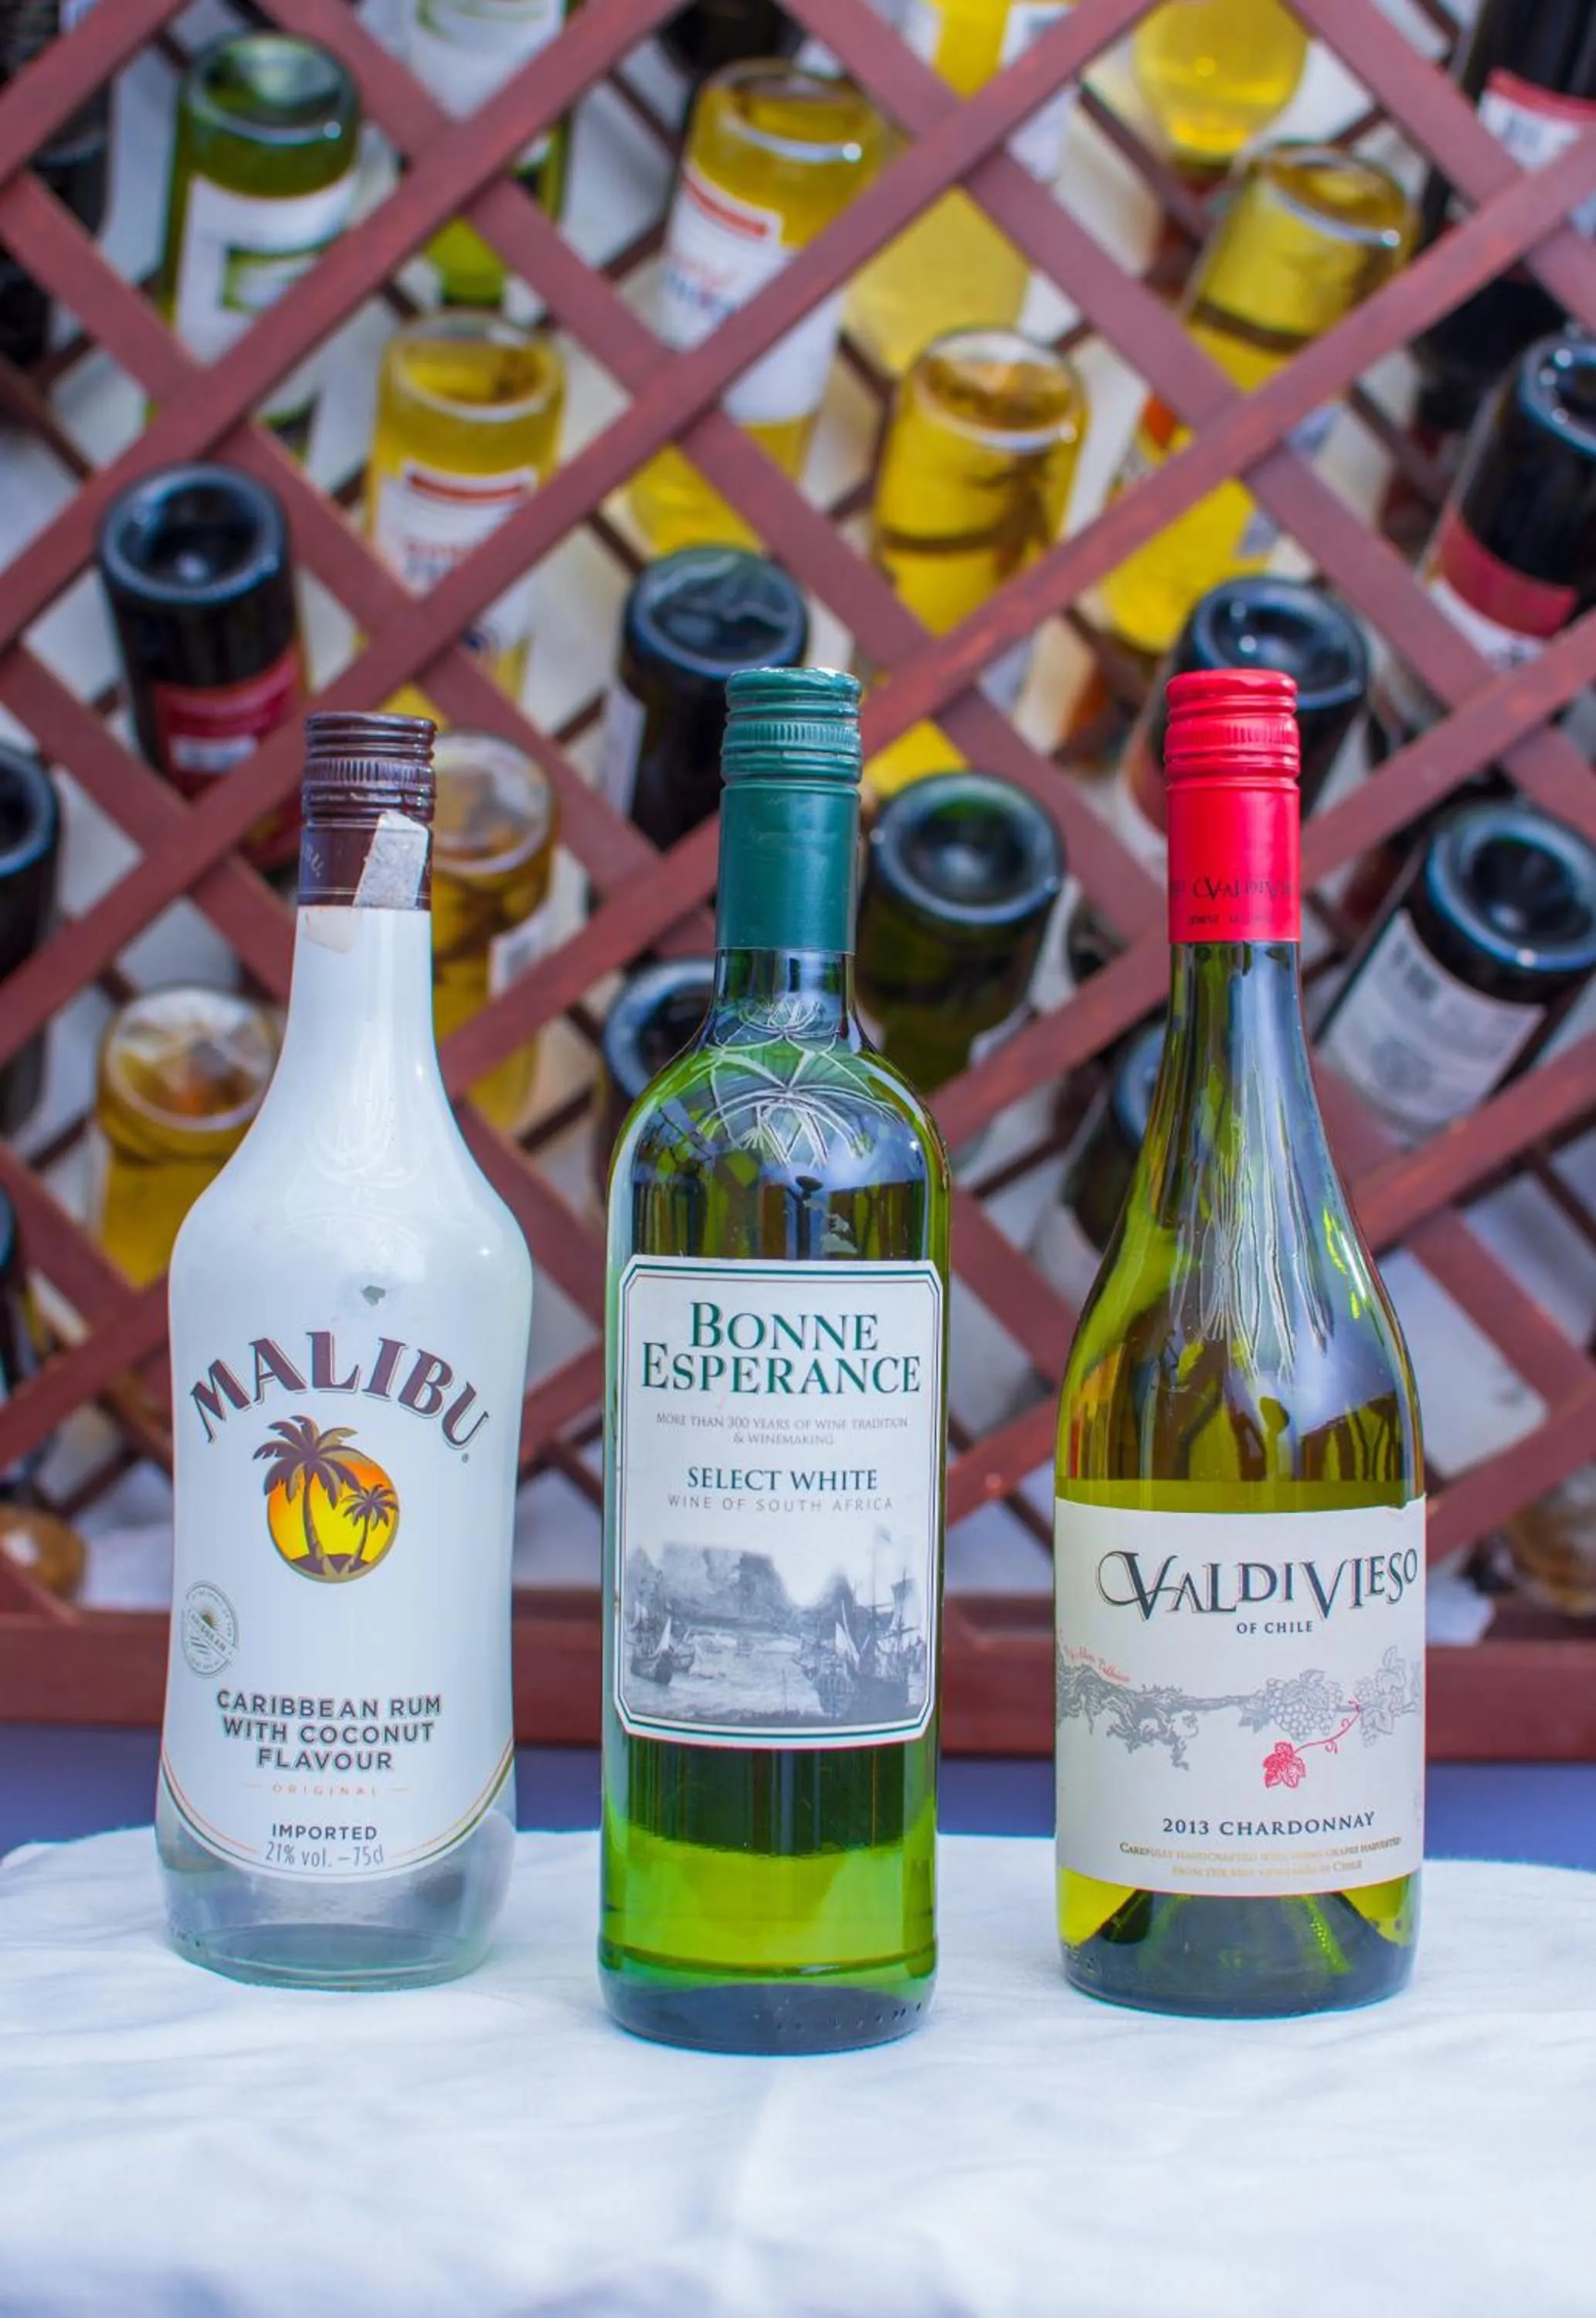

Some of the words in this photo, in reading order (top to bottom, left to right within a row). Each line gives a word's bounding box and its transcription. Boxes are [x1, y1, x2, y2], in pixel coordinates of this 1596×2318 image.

[690, 1302, 878, 1351] BONNE
[642, 1342, 921, 1394] ESPERANCE
[190, 1331, 490, 1450] MALIBU
[657, 1412, 685, 1426] MORE
[691, 1416, 724, 1427] THAN
[727, 1416, 749, 1429] 300
[752, 1418, 790, 1429] YEARS
[793, 1419, 811, 1429] OF
[815, 1419, 846, 1429] WINE
[851, 1416, 908, 1429] TRADITION
[733, 1433, 743, 1443] &
[748, 1433, 834, 1445] WINEMAKING
[688, 1467, 782, 1491] SELECT
[790, 1470, 878, 1491] WHITE
[667, 1494, 711, 1509] WINE
[722, 1497, 745, 1511] OF
[756, 1498, 821, 1512] SOUTH
[832, 1497, 894, 1512] AFRICA
[1097, 1548, 1418, 1621] VALDIVIESO
[1236, 1622, 1258, 1634] OF
[1265, 1620, 1314, 1634] CHILE
[216, 1689, 379, 1718] CARIBBEAN
[389, 1693, 441, 1717] RUM
[223, 1715, 287, 1742] WITH
[299, 1722, 434, 1744] COCONUT
[257, 1747, 393, 1771] FLAVOUR
[272, 1783, 377, 1796] ORIGINAL
[272, 1823, 378, 1840] IMPORTED
[1163, 1817, 1210, 1835] 2013
[1219, 1811, 1376, 1836] CHARDONNAY
[266, 1841, 295, 1865] 21%
[301, 1847, 332, 1868] vol.
